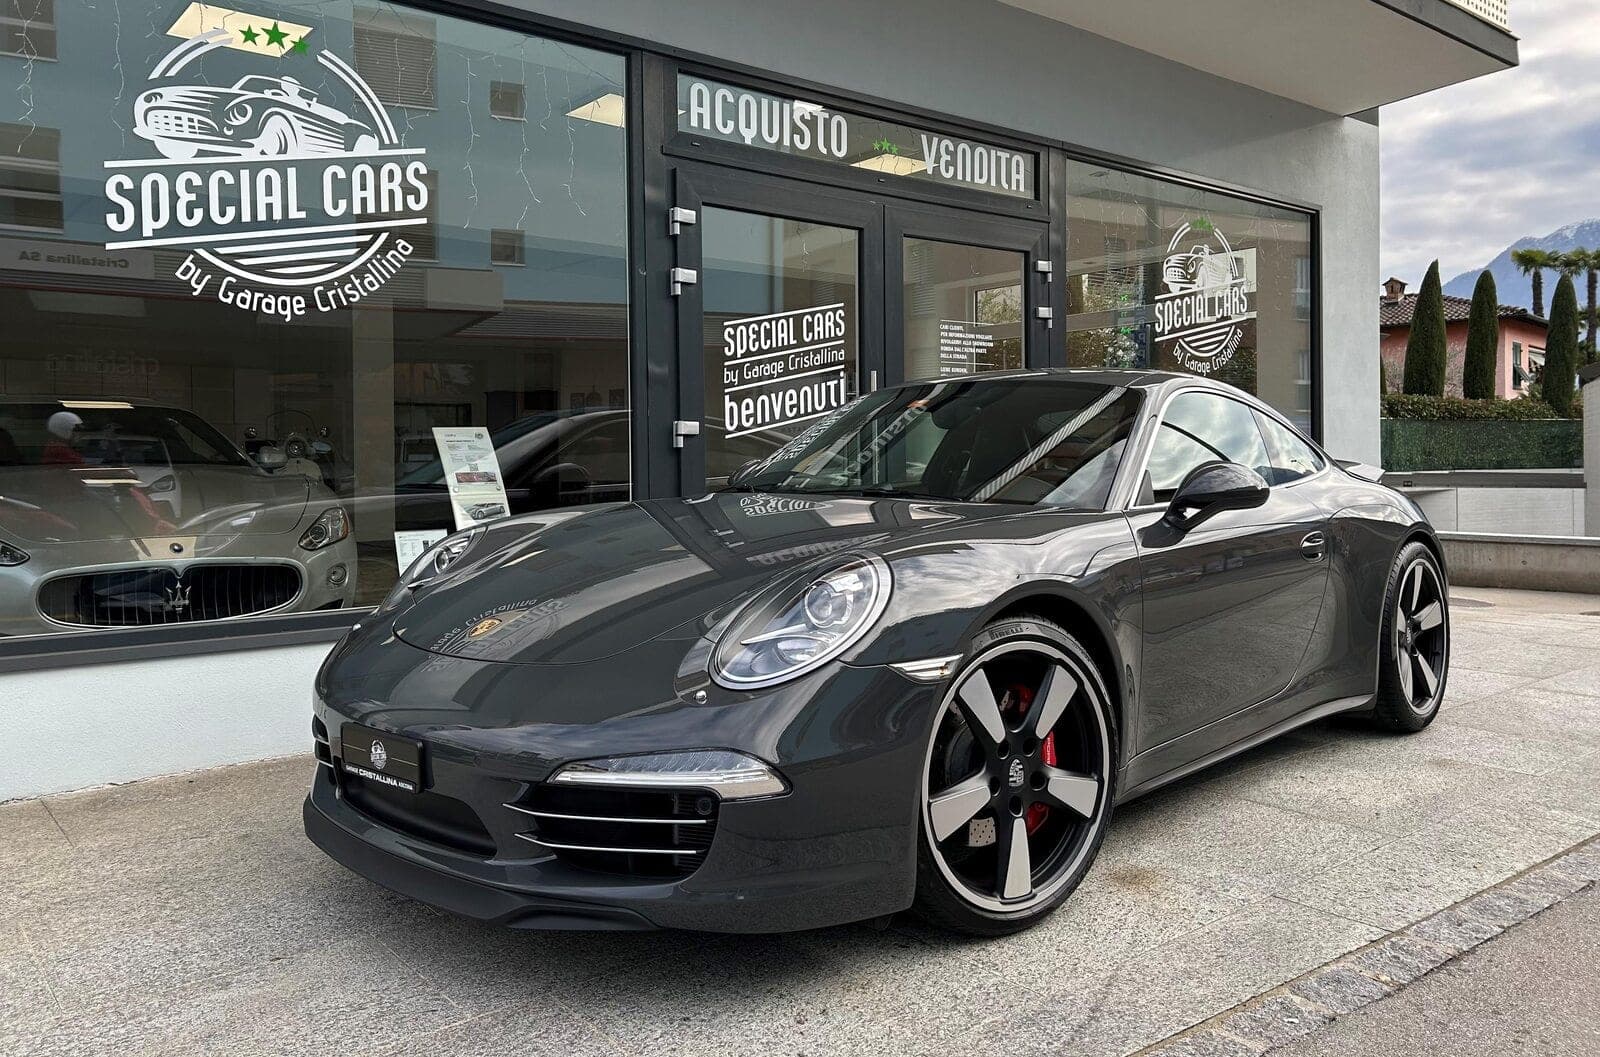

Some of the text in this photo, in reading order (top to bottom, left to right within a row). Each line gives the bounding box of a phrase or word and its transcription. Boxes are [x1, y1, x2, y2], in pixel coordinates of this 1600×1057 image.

[690, 82, 848, 158] ACQUISTO
[921, 133, 1025, 192] VENDITA
[105, 161, 428, 237] SPECIAL CARS
[174, 238, 414, 322] by Garage Cristallina
[723, 309, 845, 358] SPECIAL CARS
[1155, 285, 1248, 333] SPECIAL CARS
[723, 347, 845, 386] by Garage Cristallina
[1172, 328, 1243, 376] by Garage Cristallina
[724, 371, 845, 431] benvenuti
[358, 769, 398, 787] CRISTALLINA
